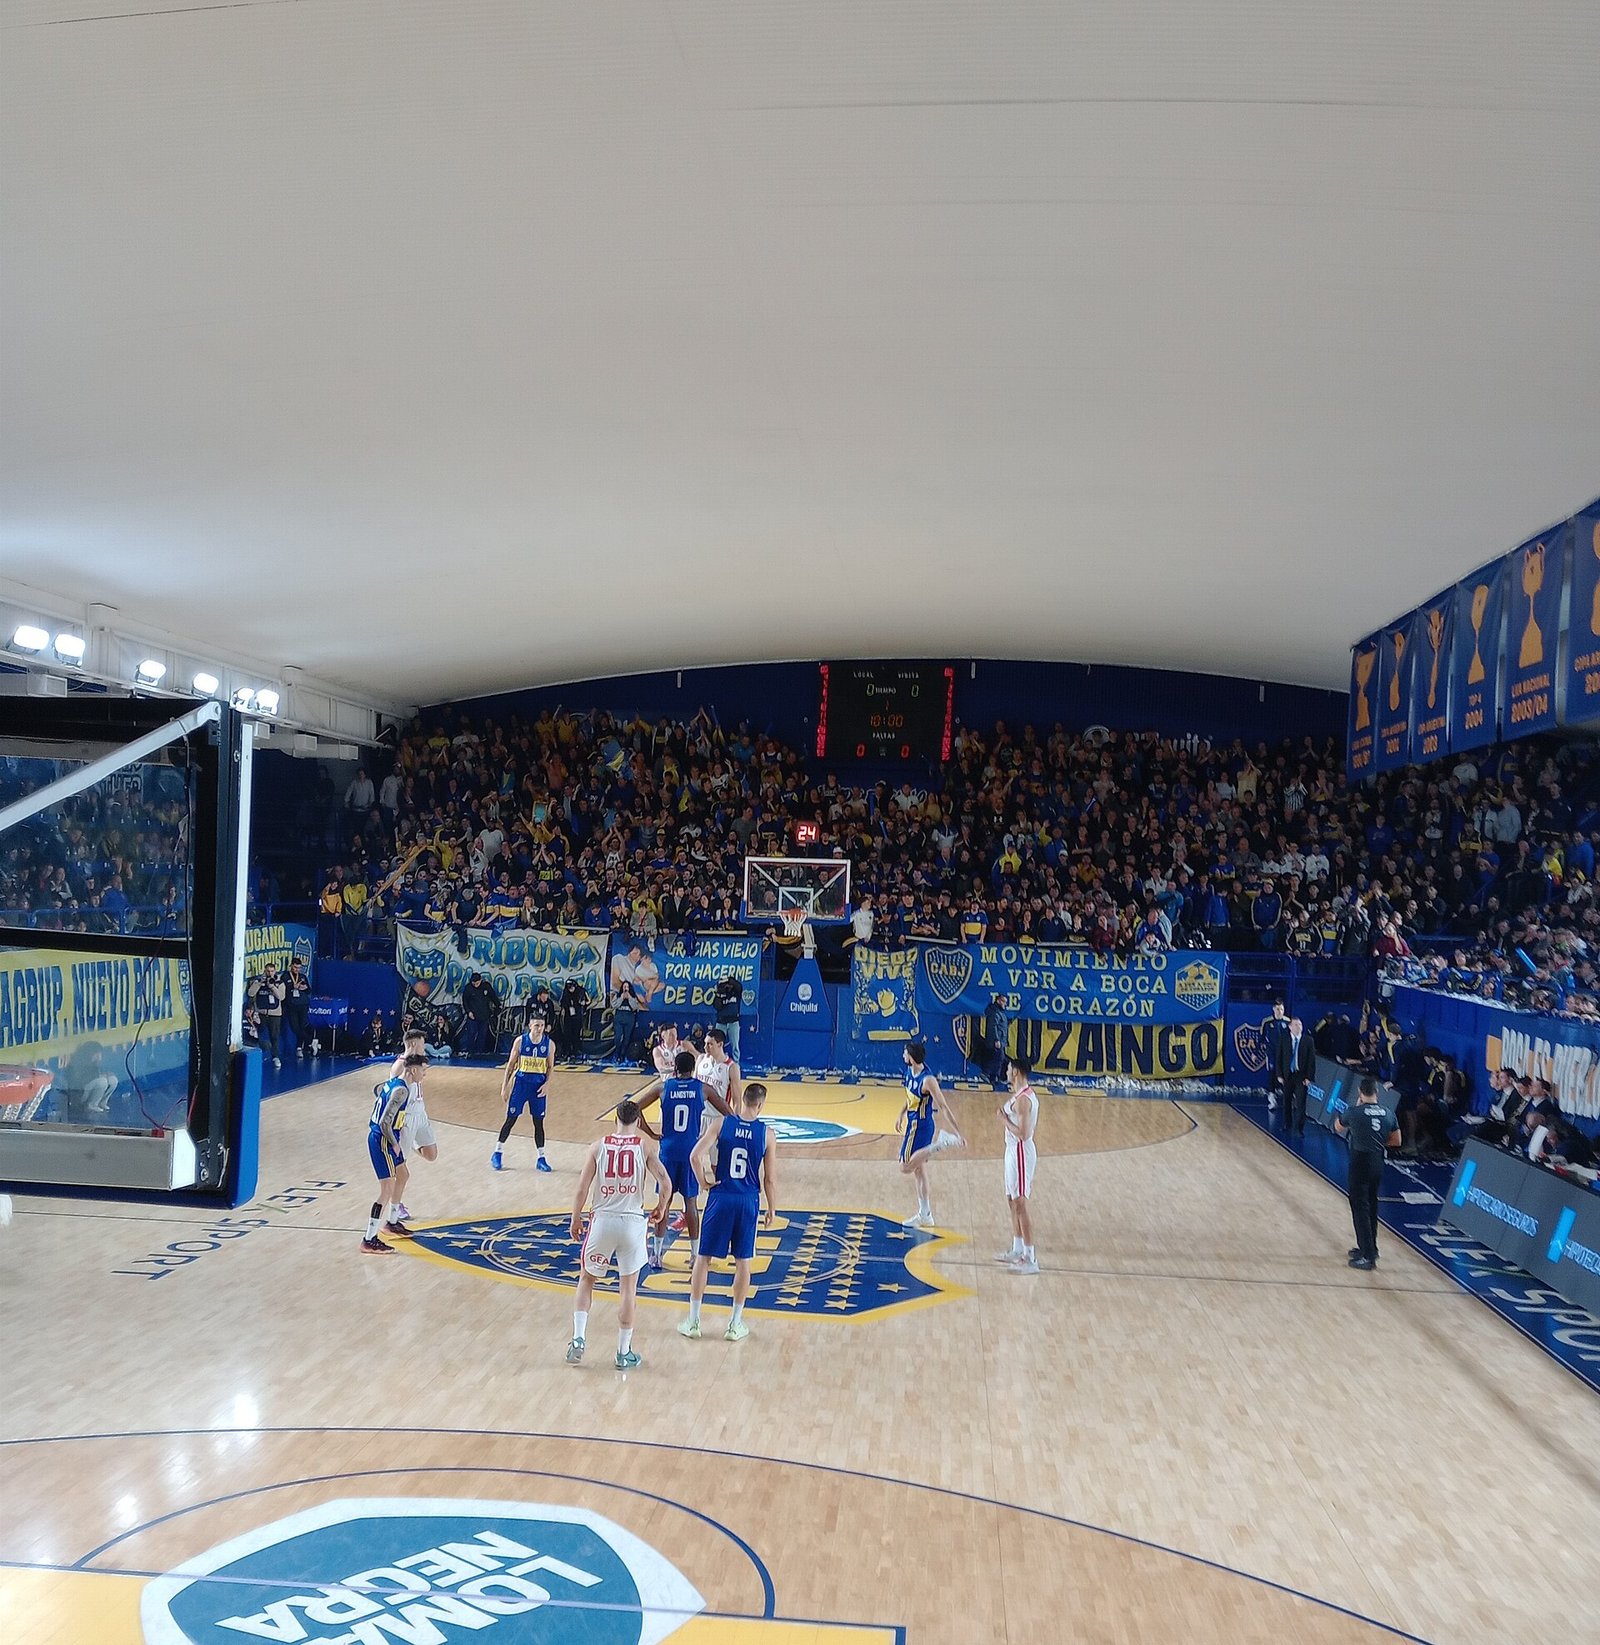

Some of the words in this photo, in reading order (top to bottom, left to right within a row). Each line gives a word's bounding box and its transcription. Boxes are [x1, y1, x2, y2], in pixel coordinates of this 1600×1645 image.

[853, 671, 874, 679] LOCAL
[898, 671, 920, 679] VISITA
[875, 686, 897, 694] TIEMPO
[911, 684, 920, 697] 0
[870, 714, 904, 727] 10:00
[872, 732, 896, 741] FALTAS
[856, 744, 865, 757] 0
[901, 744, 909, 758] 0
[797, 825, 817, 841] 24
[723, 941, 758, 959] VIEJO
[980, 946, 1168, 972] MOVIMIENTO
[404, 963, 442, 979] CABJ
[665, 963, 691, 981] POR
[694, 964, 753, 981] HACERME
[930, 960, 967, 978] CABJ
[978, 970, 996, 987] A
[1008, 970, 1057, 990] VER
[1070, 976, 1088, 992] A
[1100, 974, 1168, 995] BOCA
[72, 958, 130, 1036] NUEVO
[133, 957, 174, 1025] BOCA
[664, 986, 687, 1005] DE
[691, 985, 718, 1006] BO
[1035, 992, 1155, 1018] CORAZÓN
[670, 1090, 696, 1099] LANGSTON
[673, 1104, 689, 1132] 0
[735, 1127, 753, 1140] MATA
[605, 1149, 634, 1178] 10
[730, 1147, 748, 1179] 6
[242, 1180, 348, 1214] FLEX
[600, 1185, 615, 1199] gs
[618, 1183, 637, 1194] bio
[111, 1217, 269, 1281] SPORT
[589, 1254, 610, 1266] GEA
[214, 1530, 540, 1645] NEGRA
